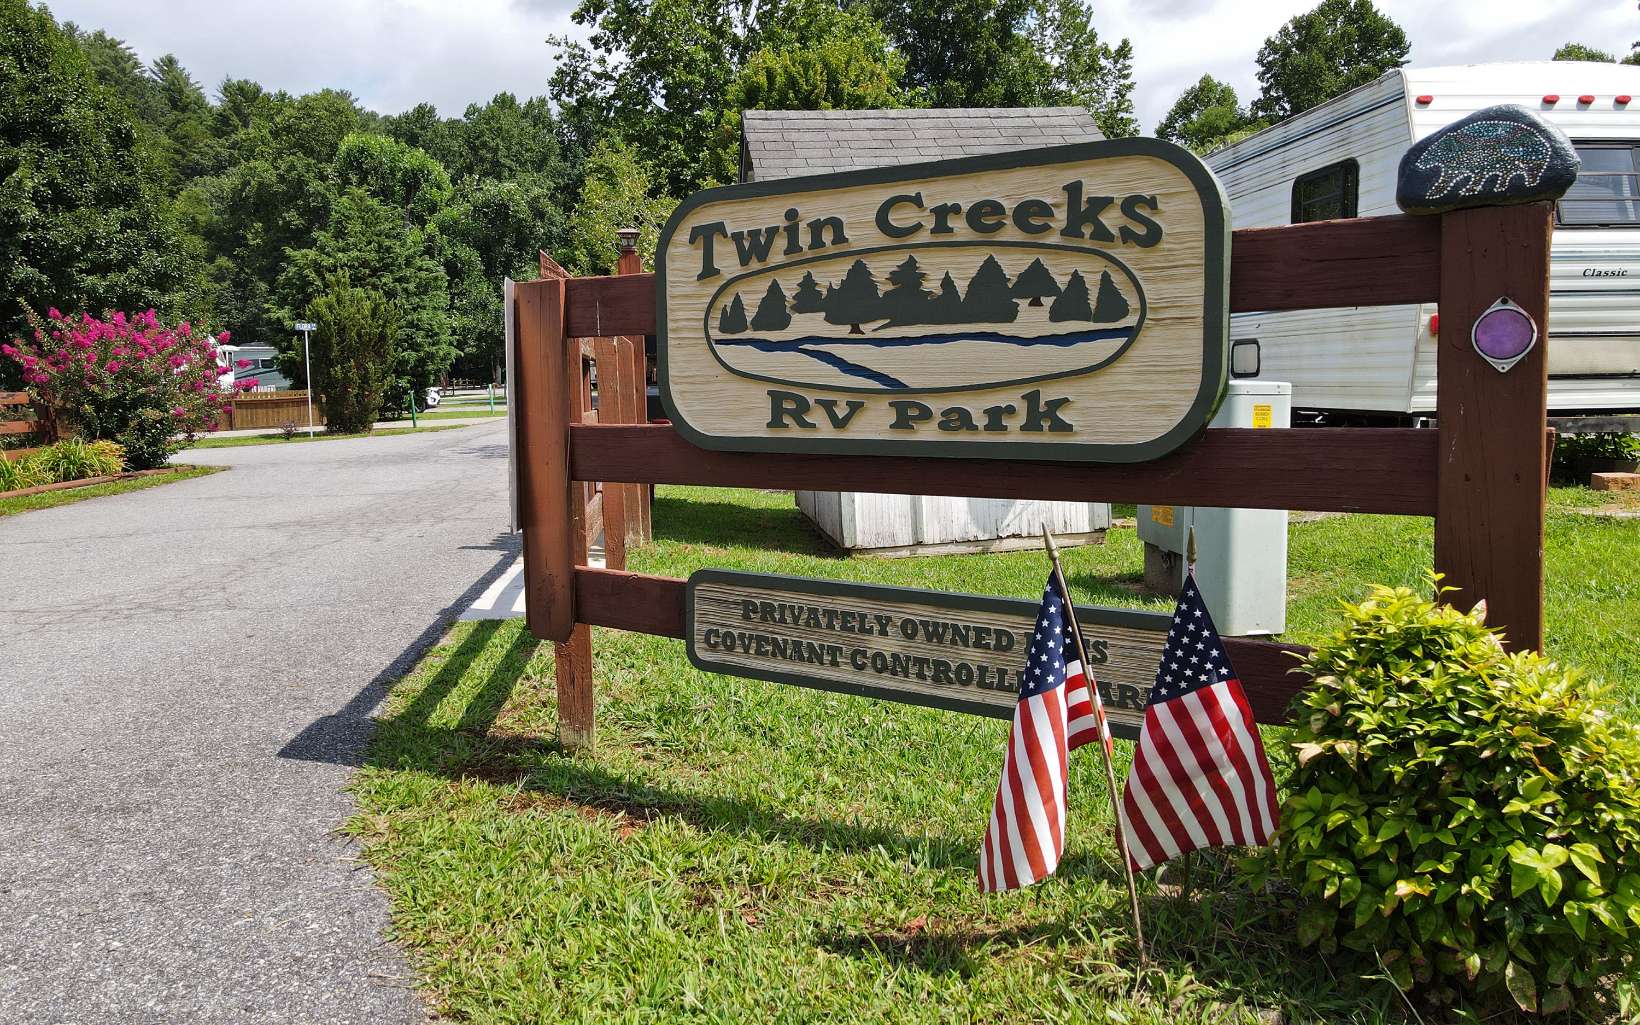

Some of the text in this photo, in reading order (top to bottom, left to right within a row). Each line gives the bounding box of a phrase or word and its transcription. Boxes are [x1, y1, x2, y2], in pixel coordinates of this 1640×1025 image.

[688, 179, 1163, 281] Twin Creeks
[1583, 267, 1627, 277] Classic
[889, 389, 1074, 433] Park
[740, 599, 892, 637] PRIVATELY
[900, 617, 1015, 652] OWNED
[704, 628, 844, 668] COVENANT
[849, 648, 1025, 692] CONTROLL
